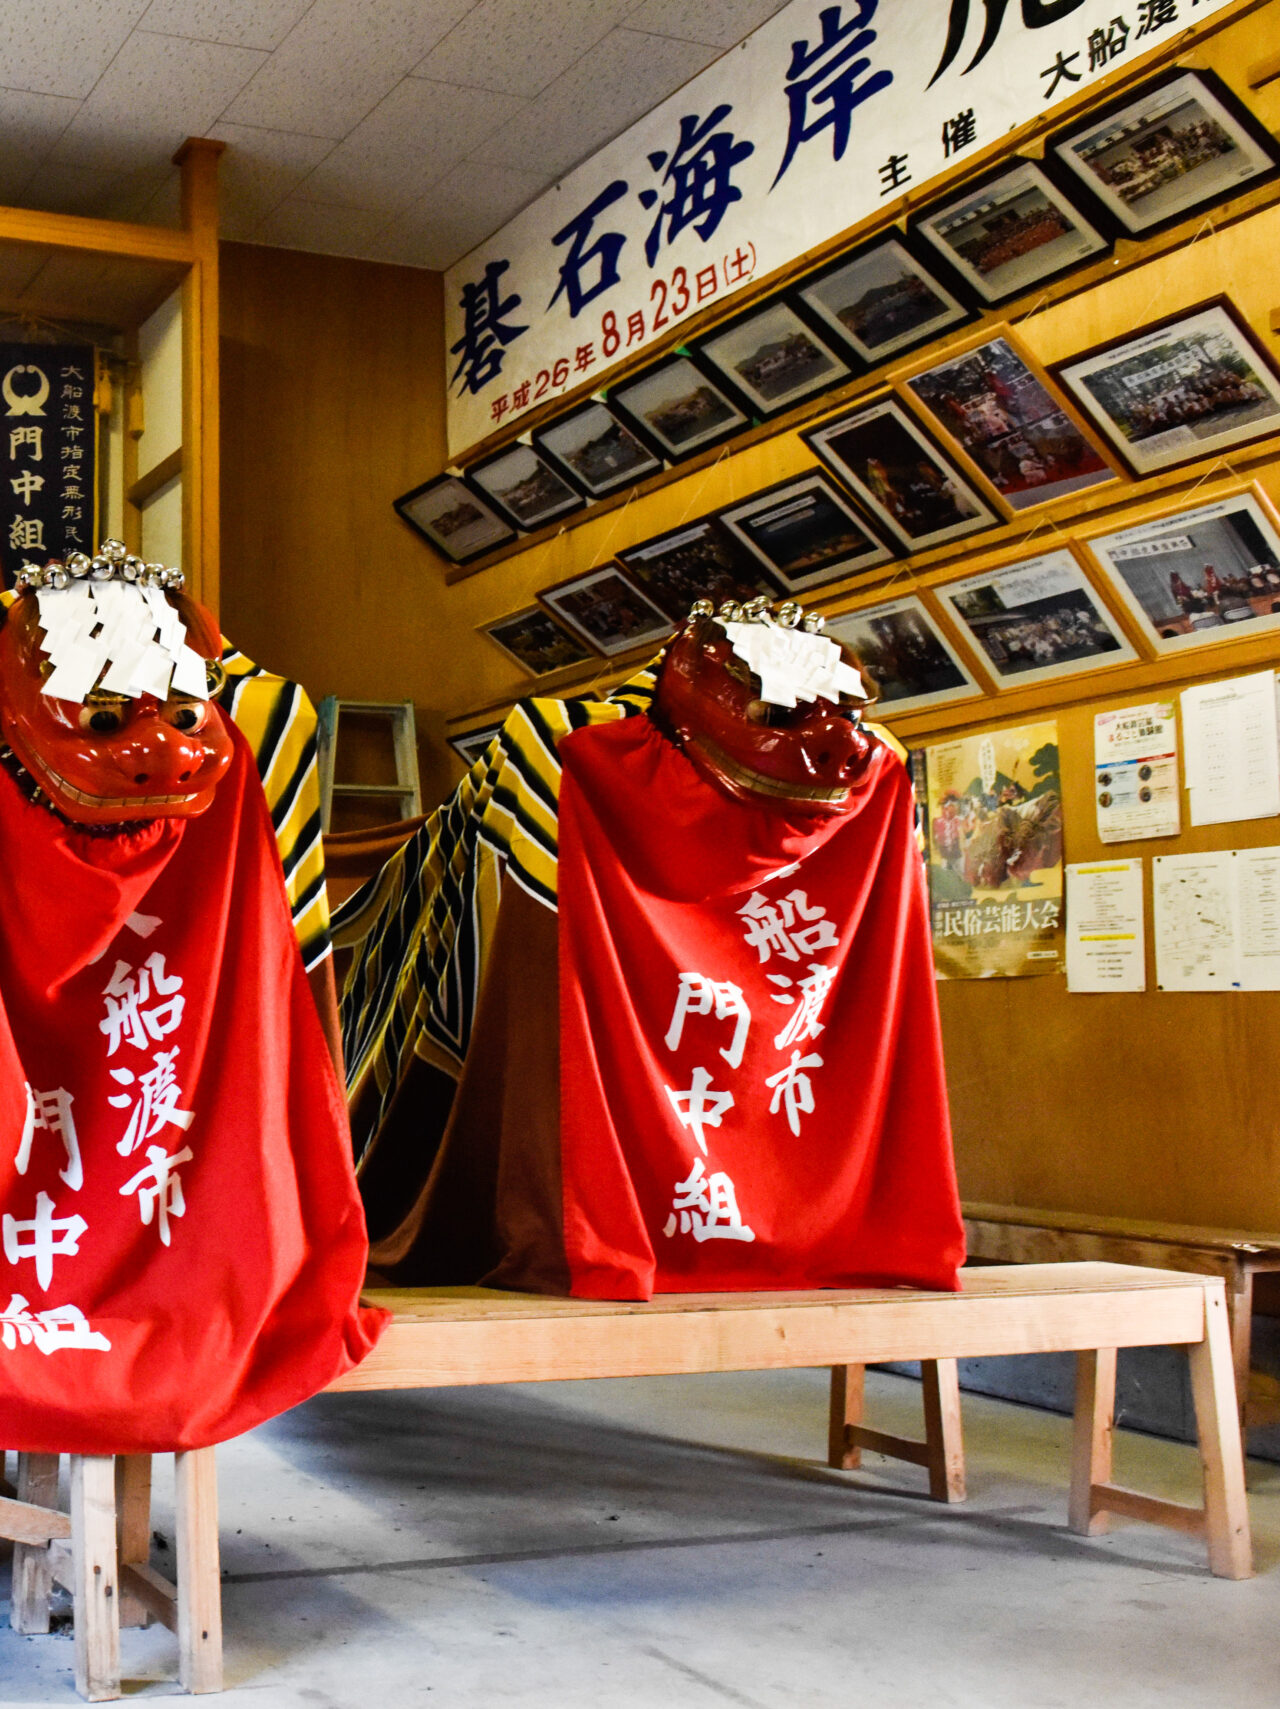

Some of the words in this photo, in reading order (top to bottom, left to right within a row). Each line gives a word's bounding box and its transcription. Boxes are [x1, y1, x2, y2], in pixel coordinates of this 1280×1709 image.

[1040, 0, 1218, 99] 大船渡
[7, 425, 48, 586] 門中組
[59, 364, 86, 554] 大船渡市指定無形民
[735, 864, 840, 1138] 船渡市
[943, 900, 1060, 937] 民俗芸能大会
[89, 911, 195, 1247] 船渡市
[663, 972, 755, 1243] 門中組
